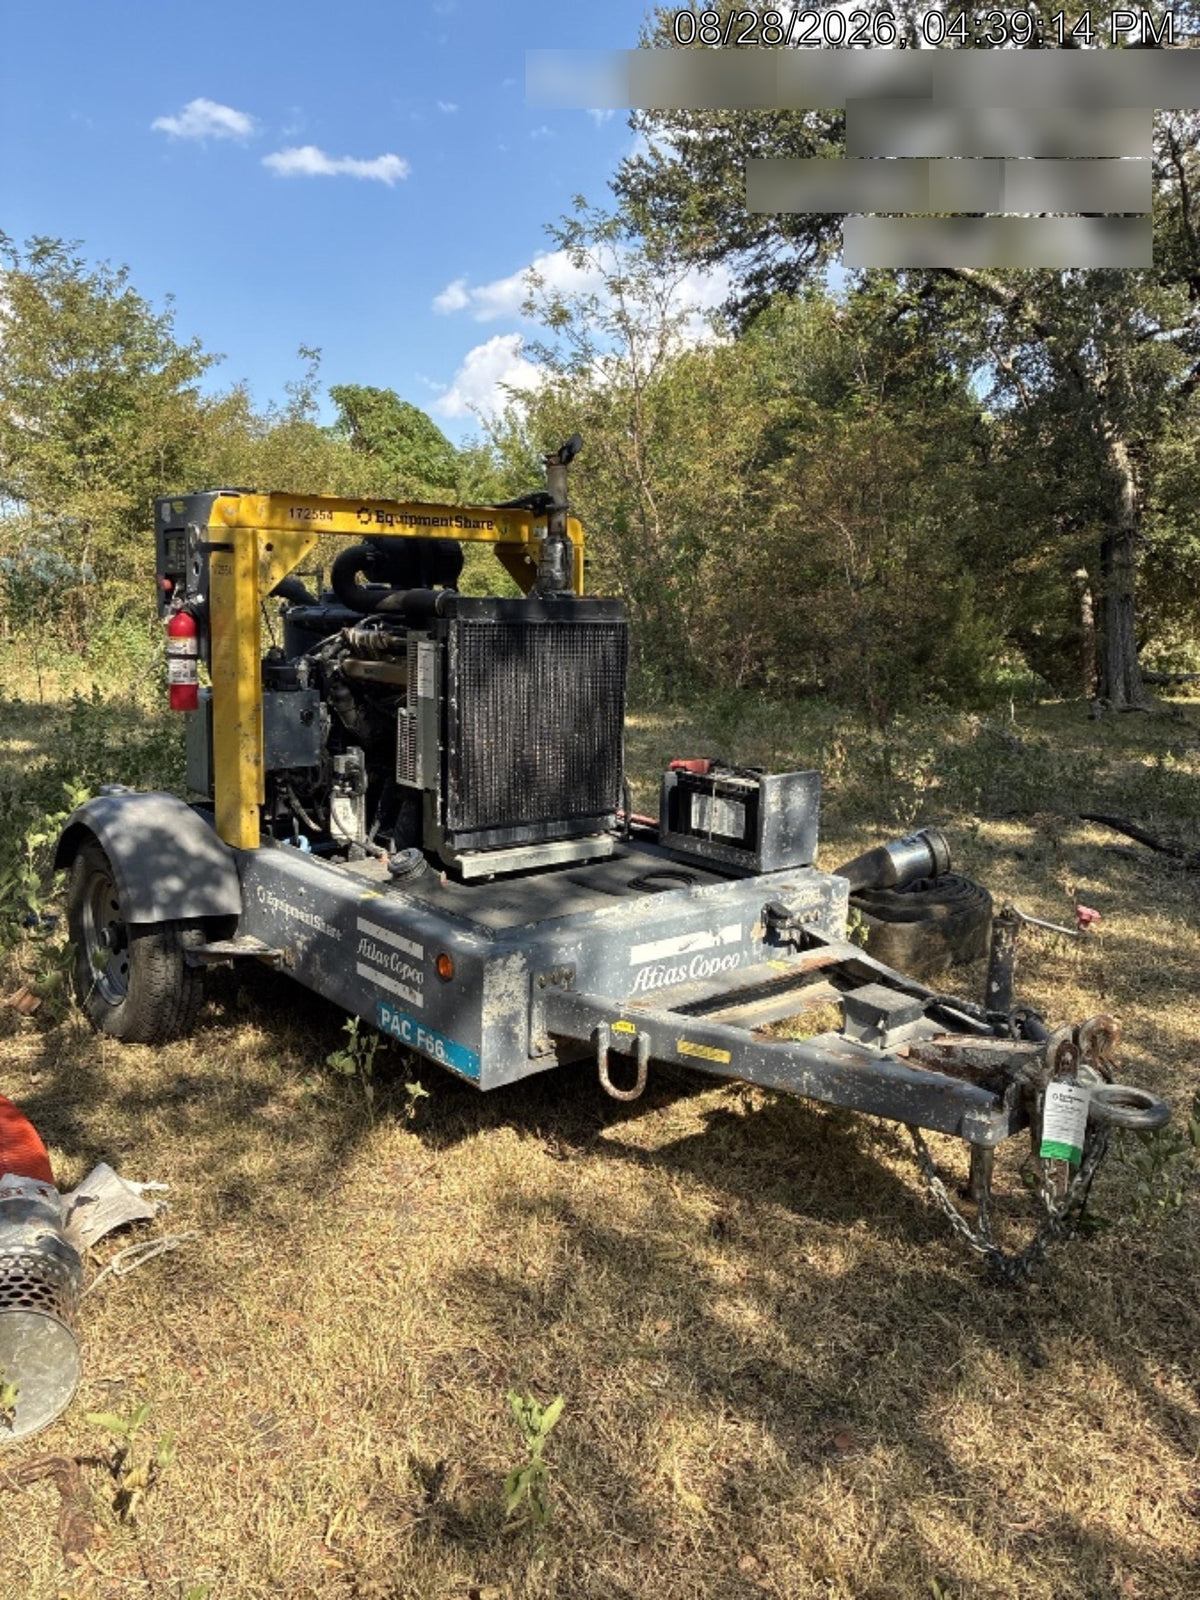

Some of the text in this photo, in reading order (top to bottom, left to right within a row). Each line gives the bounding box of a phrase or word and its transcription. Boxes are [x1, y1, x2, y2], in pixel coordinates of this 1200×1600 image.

[290, 507, 333, 520] 172554
[375, 509, 494, 530] EquipmentShare
[356, 938, 424, 985] Atlas Copco
[689, 953, 740, 978] Copco
[380, 1007, 446, 1059] PAC F66
